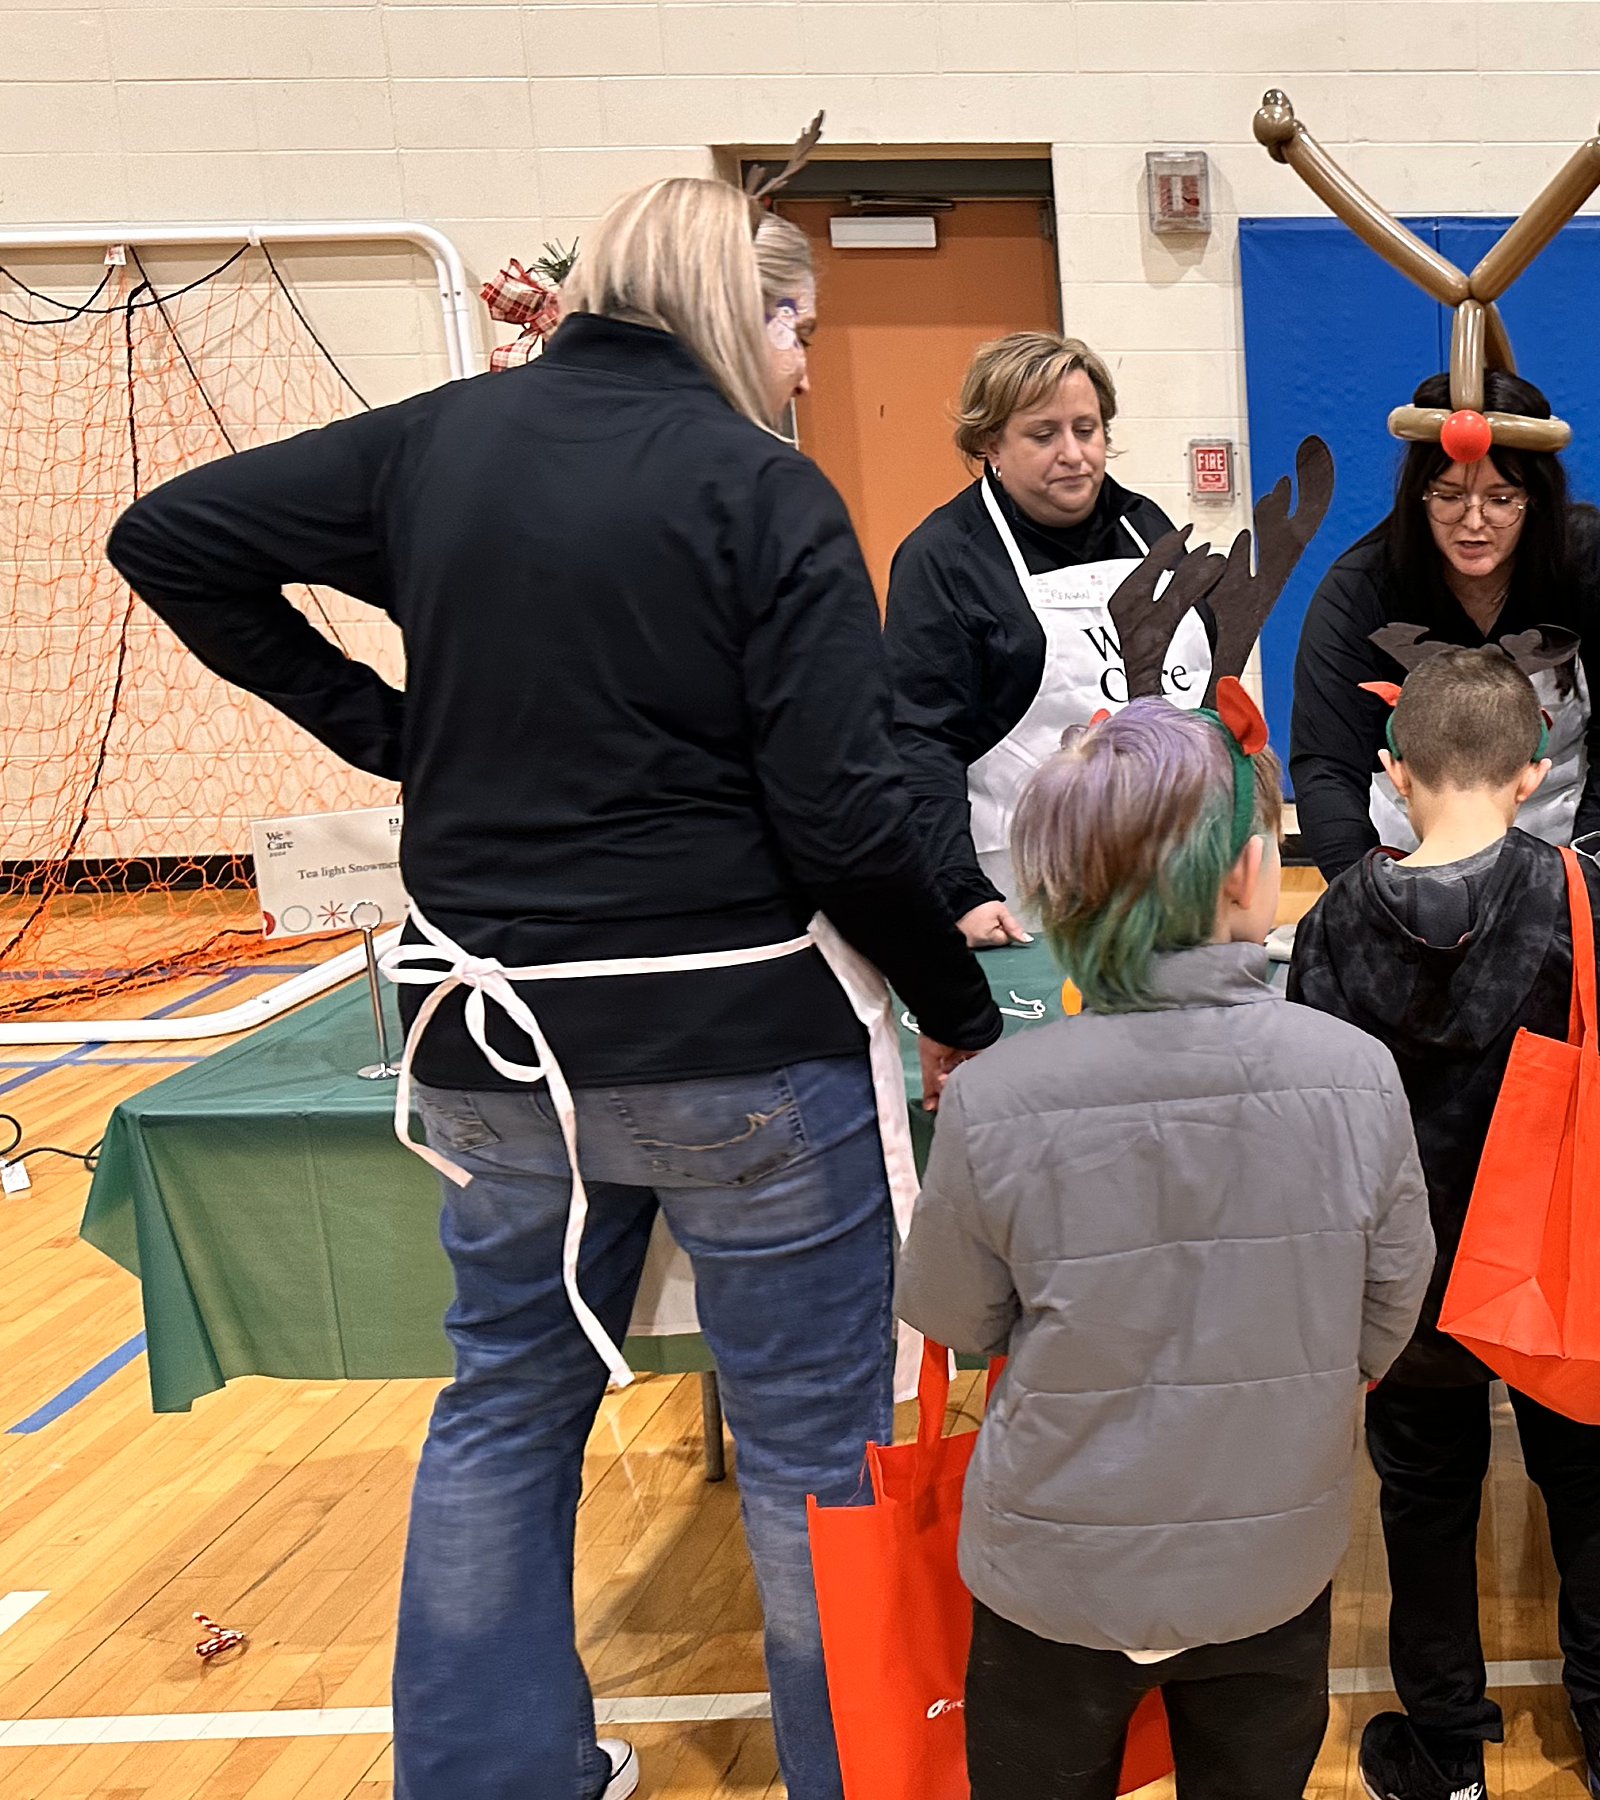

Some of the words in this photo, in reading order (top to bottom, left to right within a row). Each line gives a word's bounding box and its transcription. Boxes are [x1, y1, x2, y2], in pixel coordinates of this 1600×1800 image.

[1197, 453, 1224, 470] FIRE
[1080, 626, 1124, 661] W
[266, 832, 284, 840] We
[267, 840, 294, 851] Care
[297, 869, 319, 880] Tea
[321, 866, 346, 878] light
[1450, 1782, 1478, 1800] NIKE
